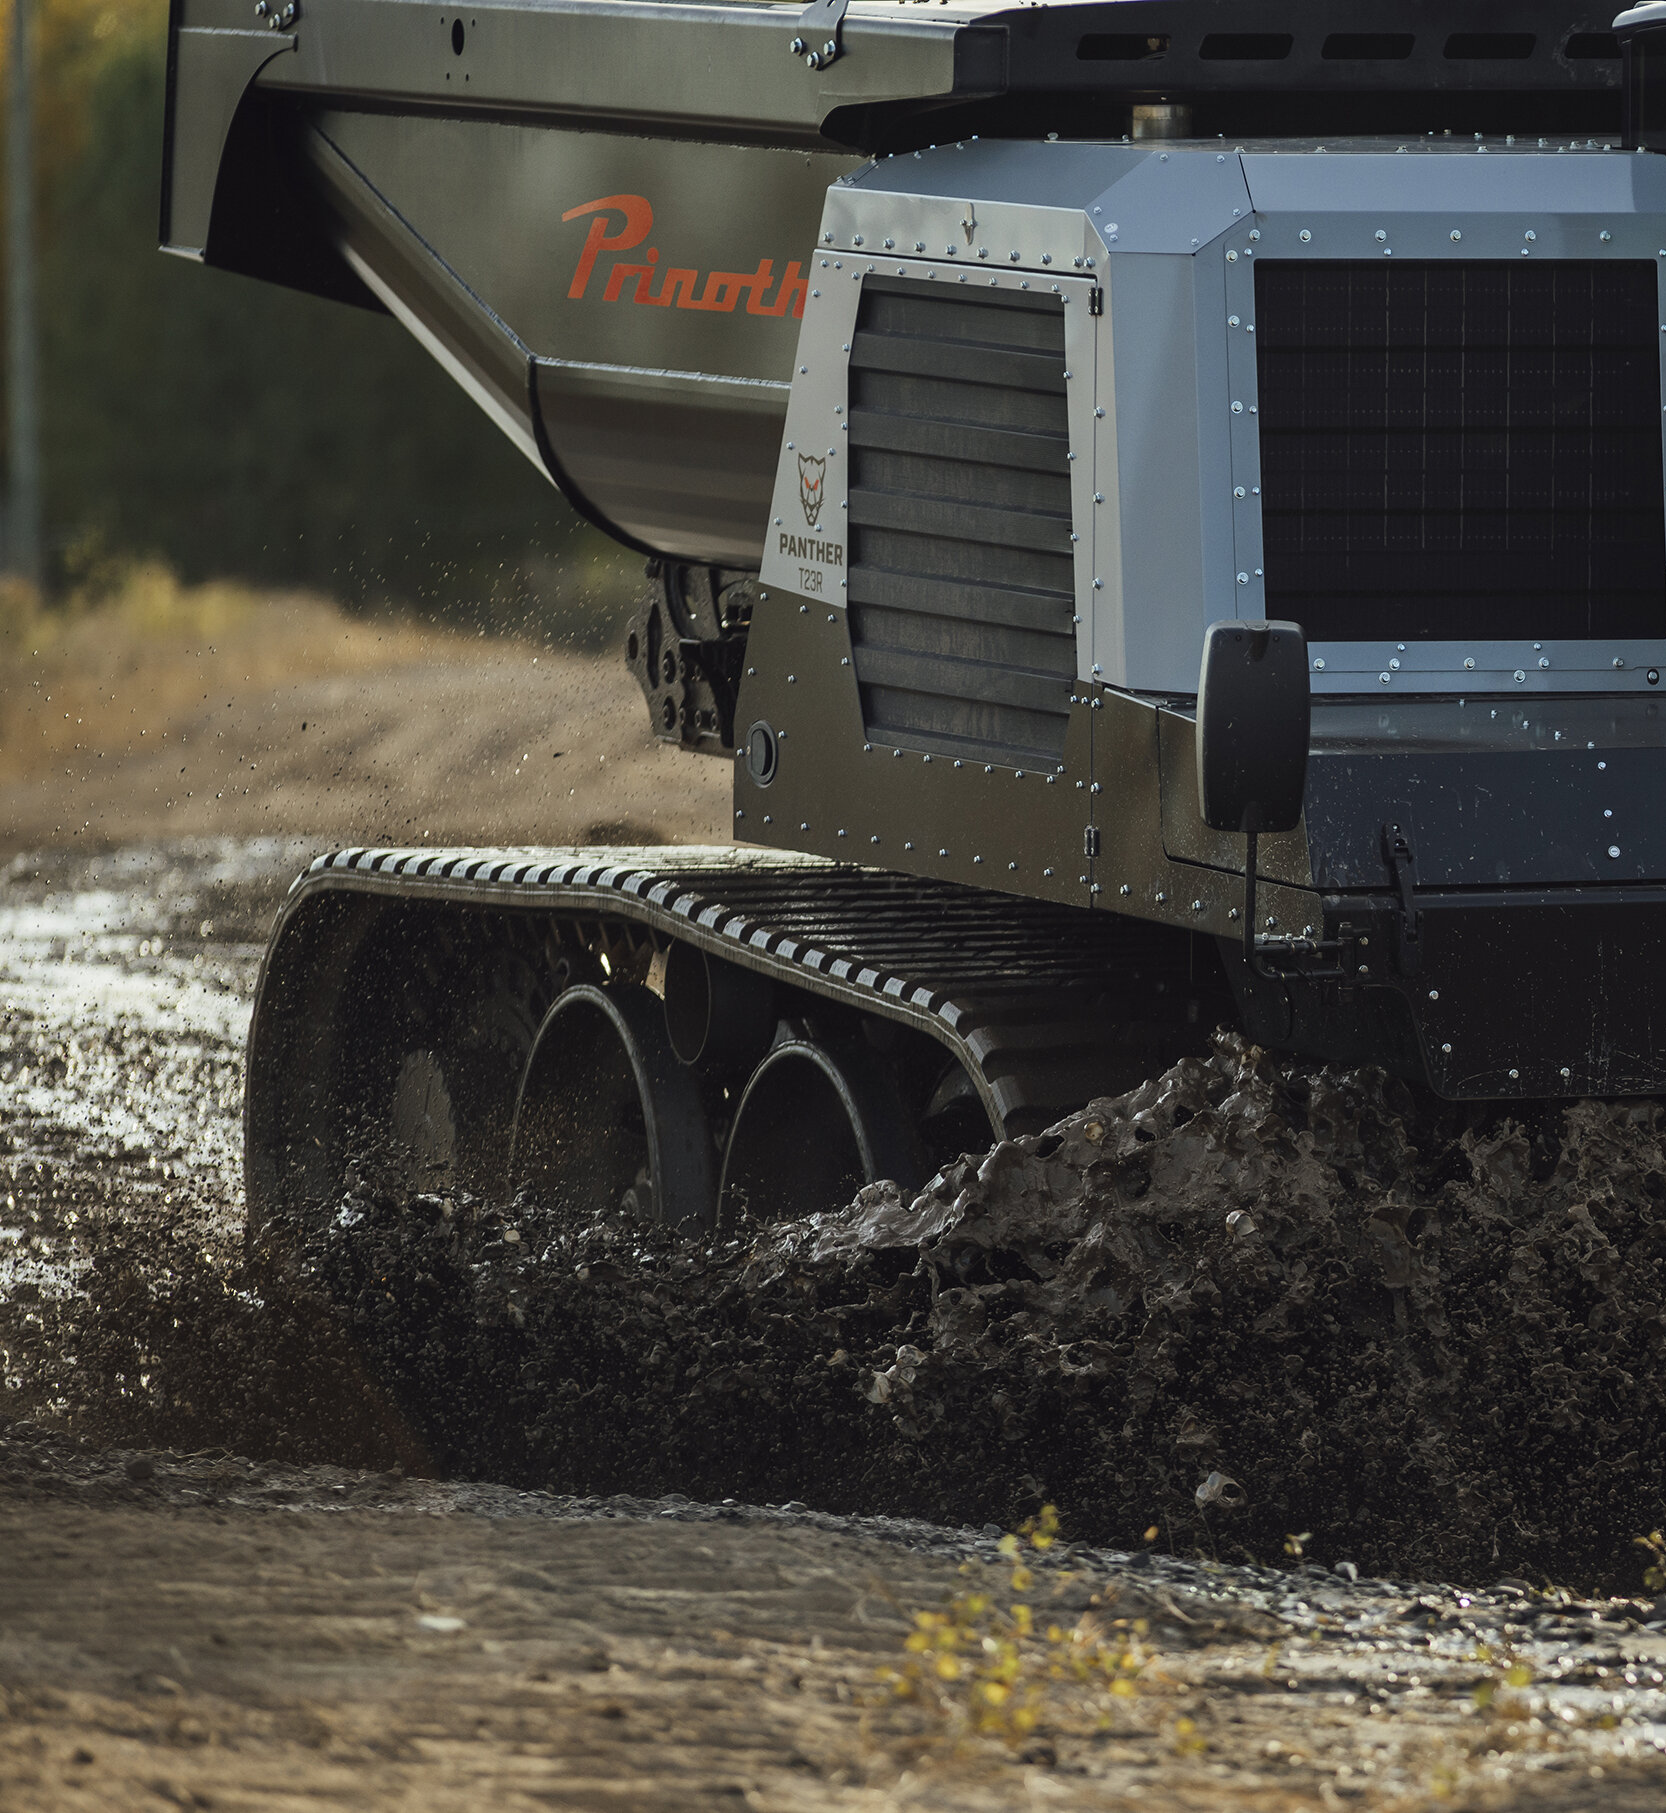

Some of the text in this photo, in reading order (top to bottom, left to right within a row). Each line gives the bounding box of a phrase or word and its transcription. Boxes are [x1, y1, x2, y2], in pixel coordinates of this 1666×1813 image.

[562, 194, 809, 319] Prinoth
[780, 533, 843, 566] PANTHER
[799, 567, 823, 593] T23R
